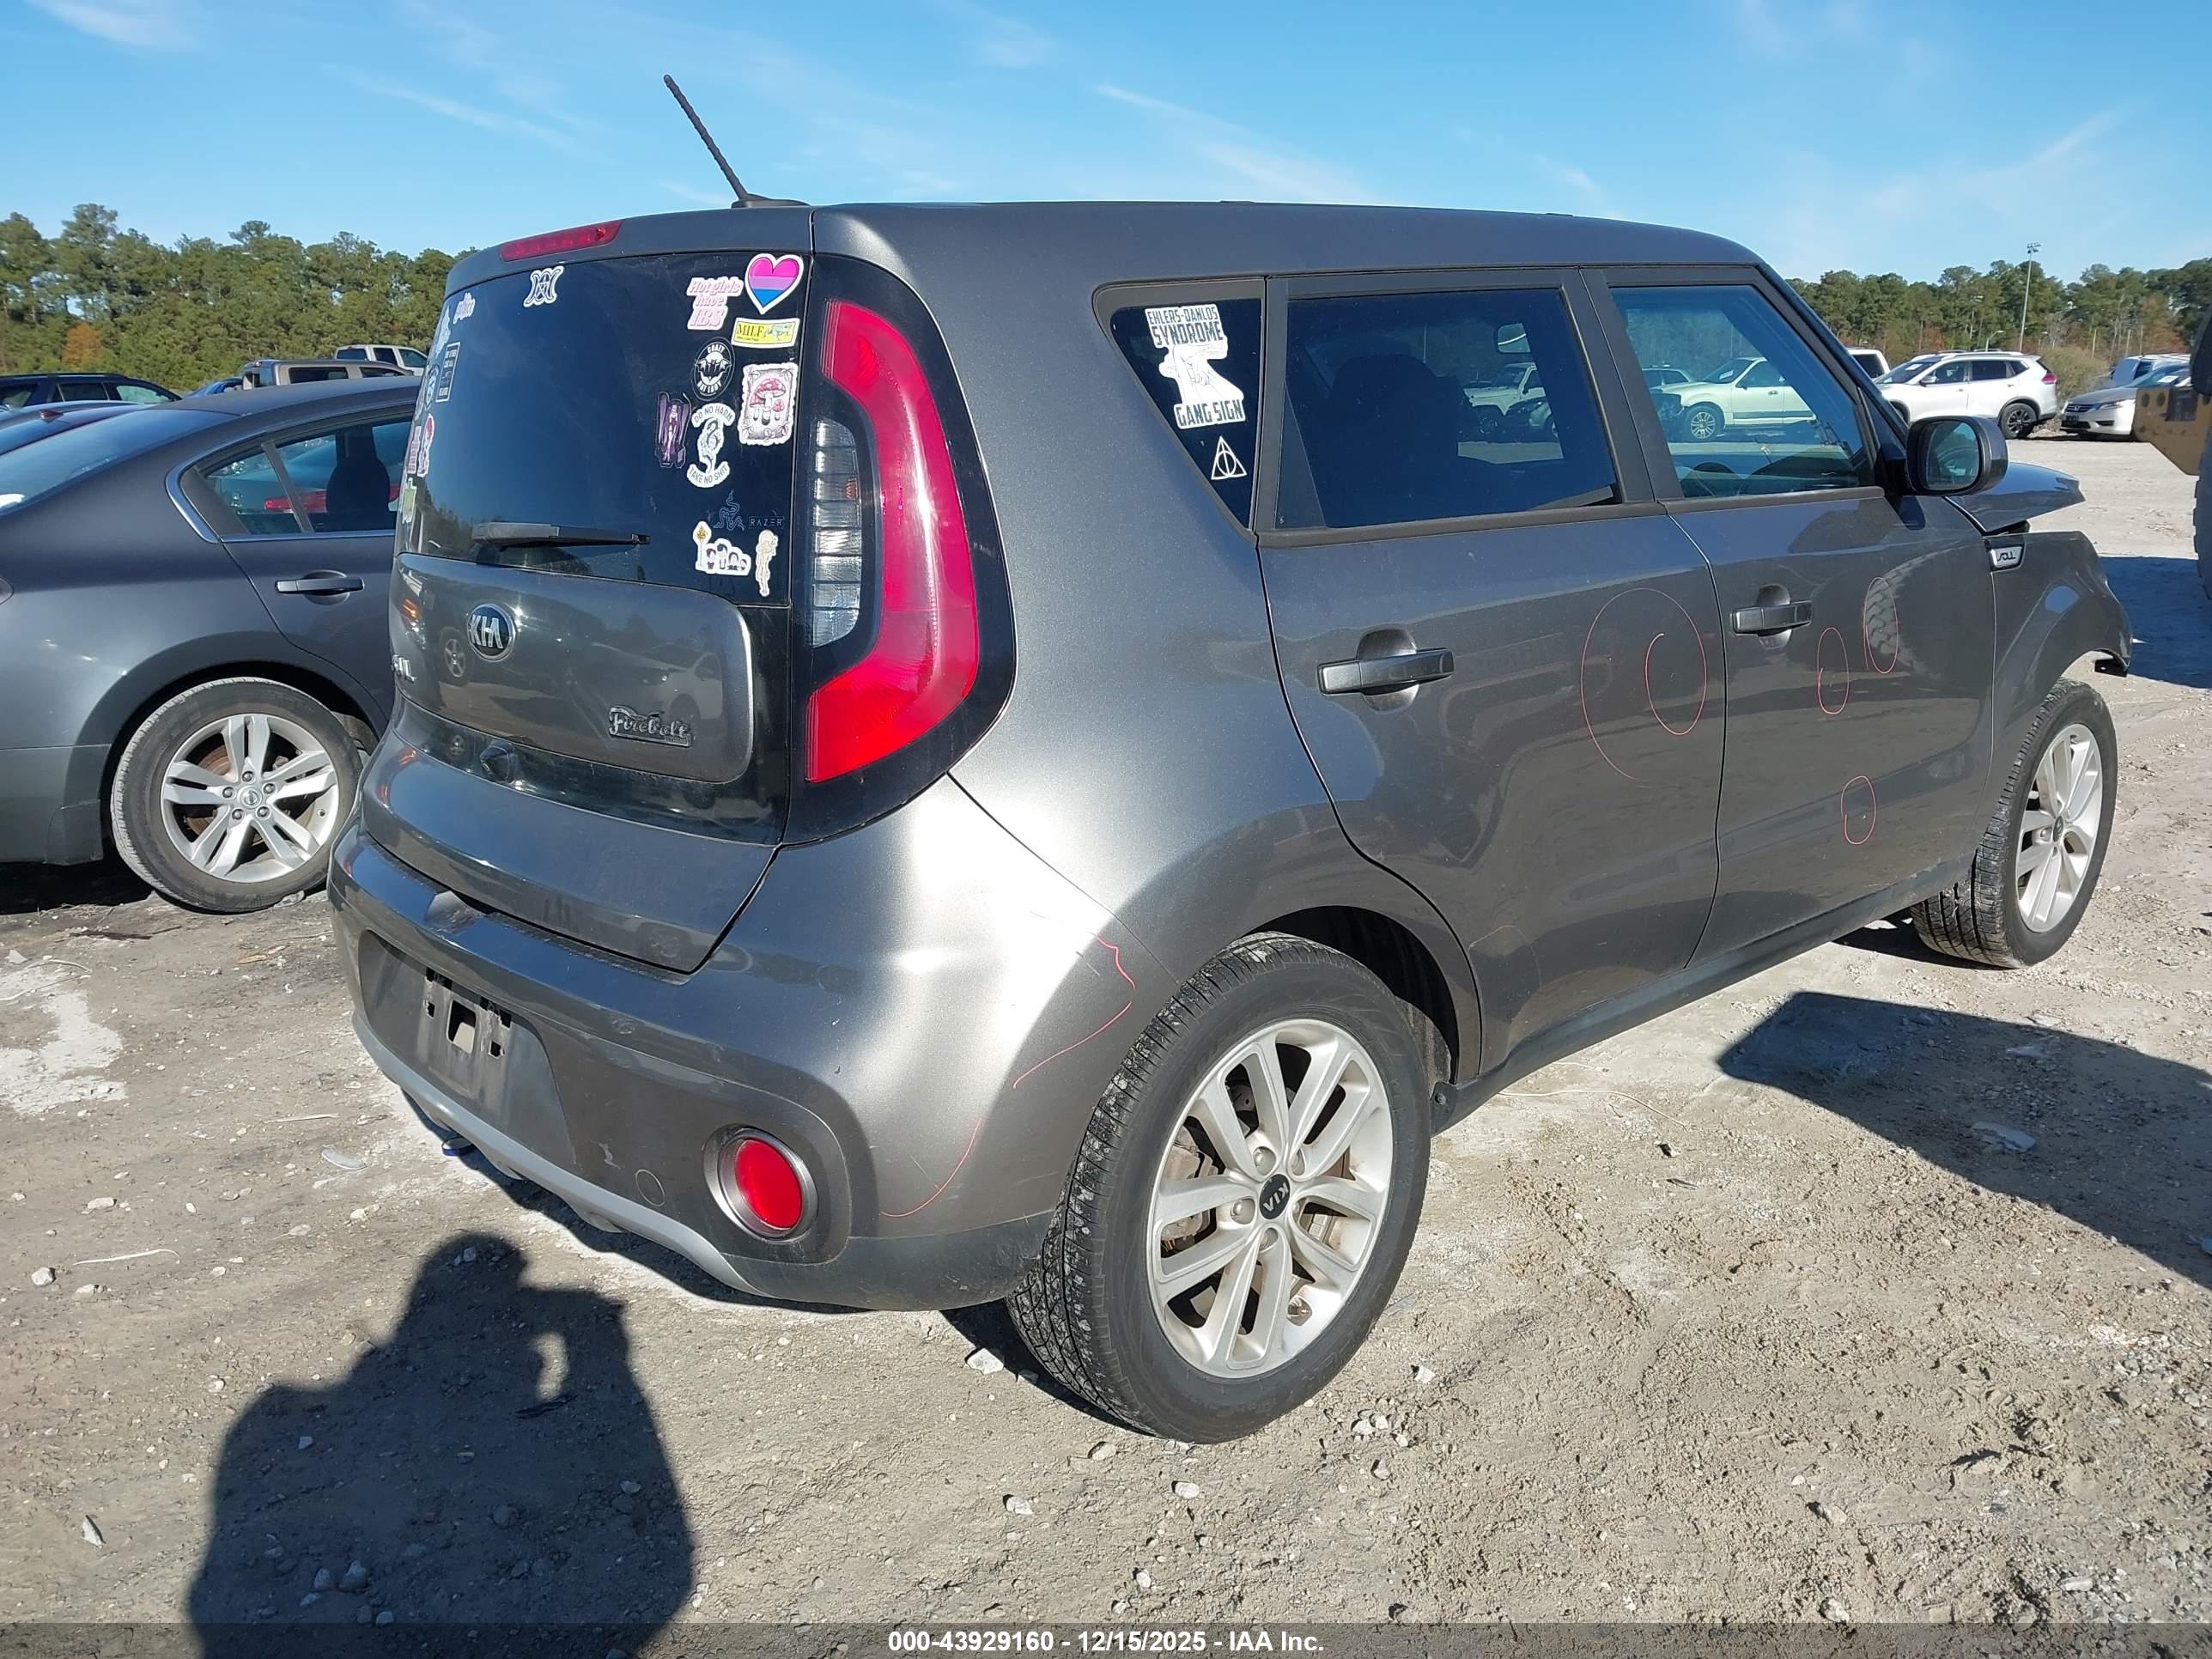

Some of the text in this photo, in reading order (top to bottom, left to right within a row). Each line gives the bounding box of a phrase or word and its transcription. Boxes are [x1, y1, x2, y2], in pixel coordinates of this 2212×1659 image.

[690, 308, 725, 327] IBS
[1147, 306, 1219, 325] EHLERS-DANLOS
[737, 324, 764, 337] MILF
[1151, 321, 1224, 346] SYNDROME
[694, 404, 733, 423] DO NO HARM
[1176, 399, 1244, 428] GANG SIGN
[689, 465, 728, 484] TAKE NO SHIT
[468, 613, 504, 649] KIA
[1262, 1182, 1290, 1212] KIA
